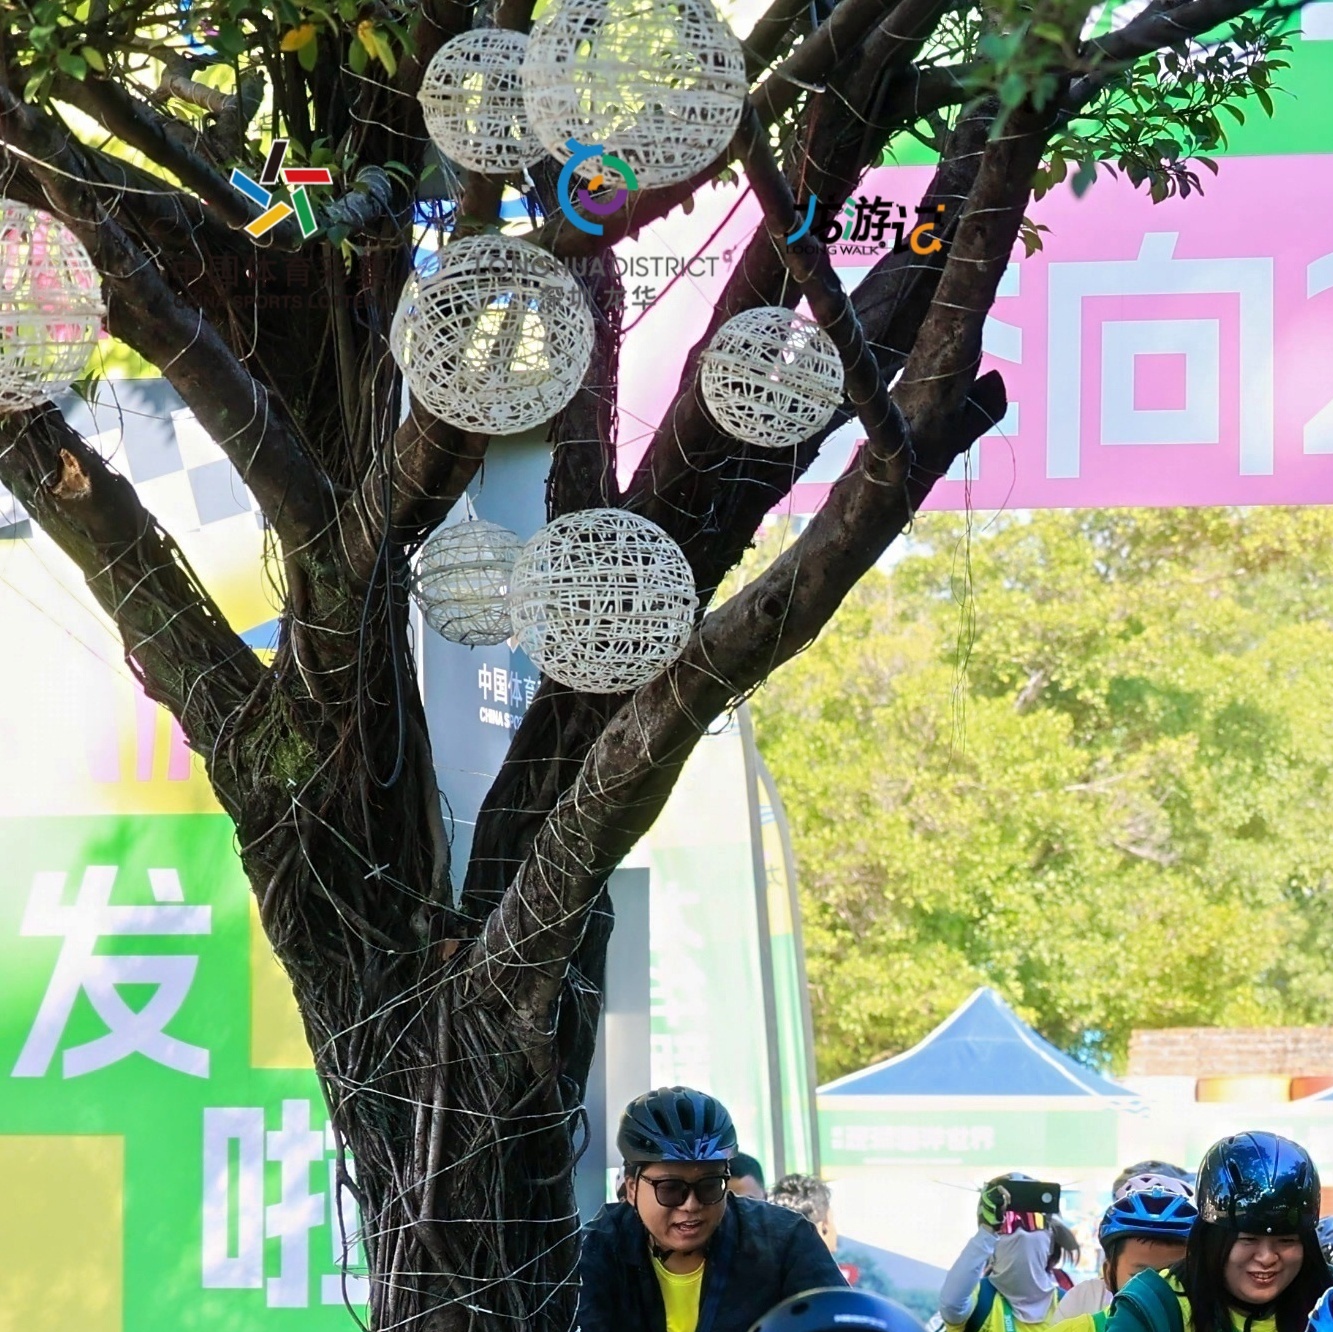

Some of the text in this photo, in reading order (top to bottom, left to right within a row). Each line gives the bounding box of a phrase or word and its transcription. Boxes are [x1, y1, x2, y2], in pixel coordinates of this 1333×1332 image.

[478, 663, 541, 709] 中国体育
[479, 706, 523, 730] CHINA SPO
[10, 865, 212, 1081] 发
